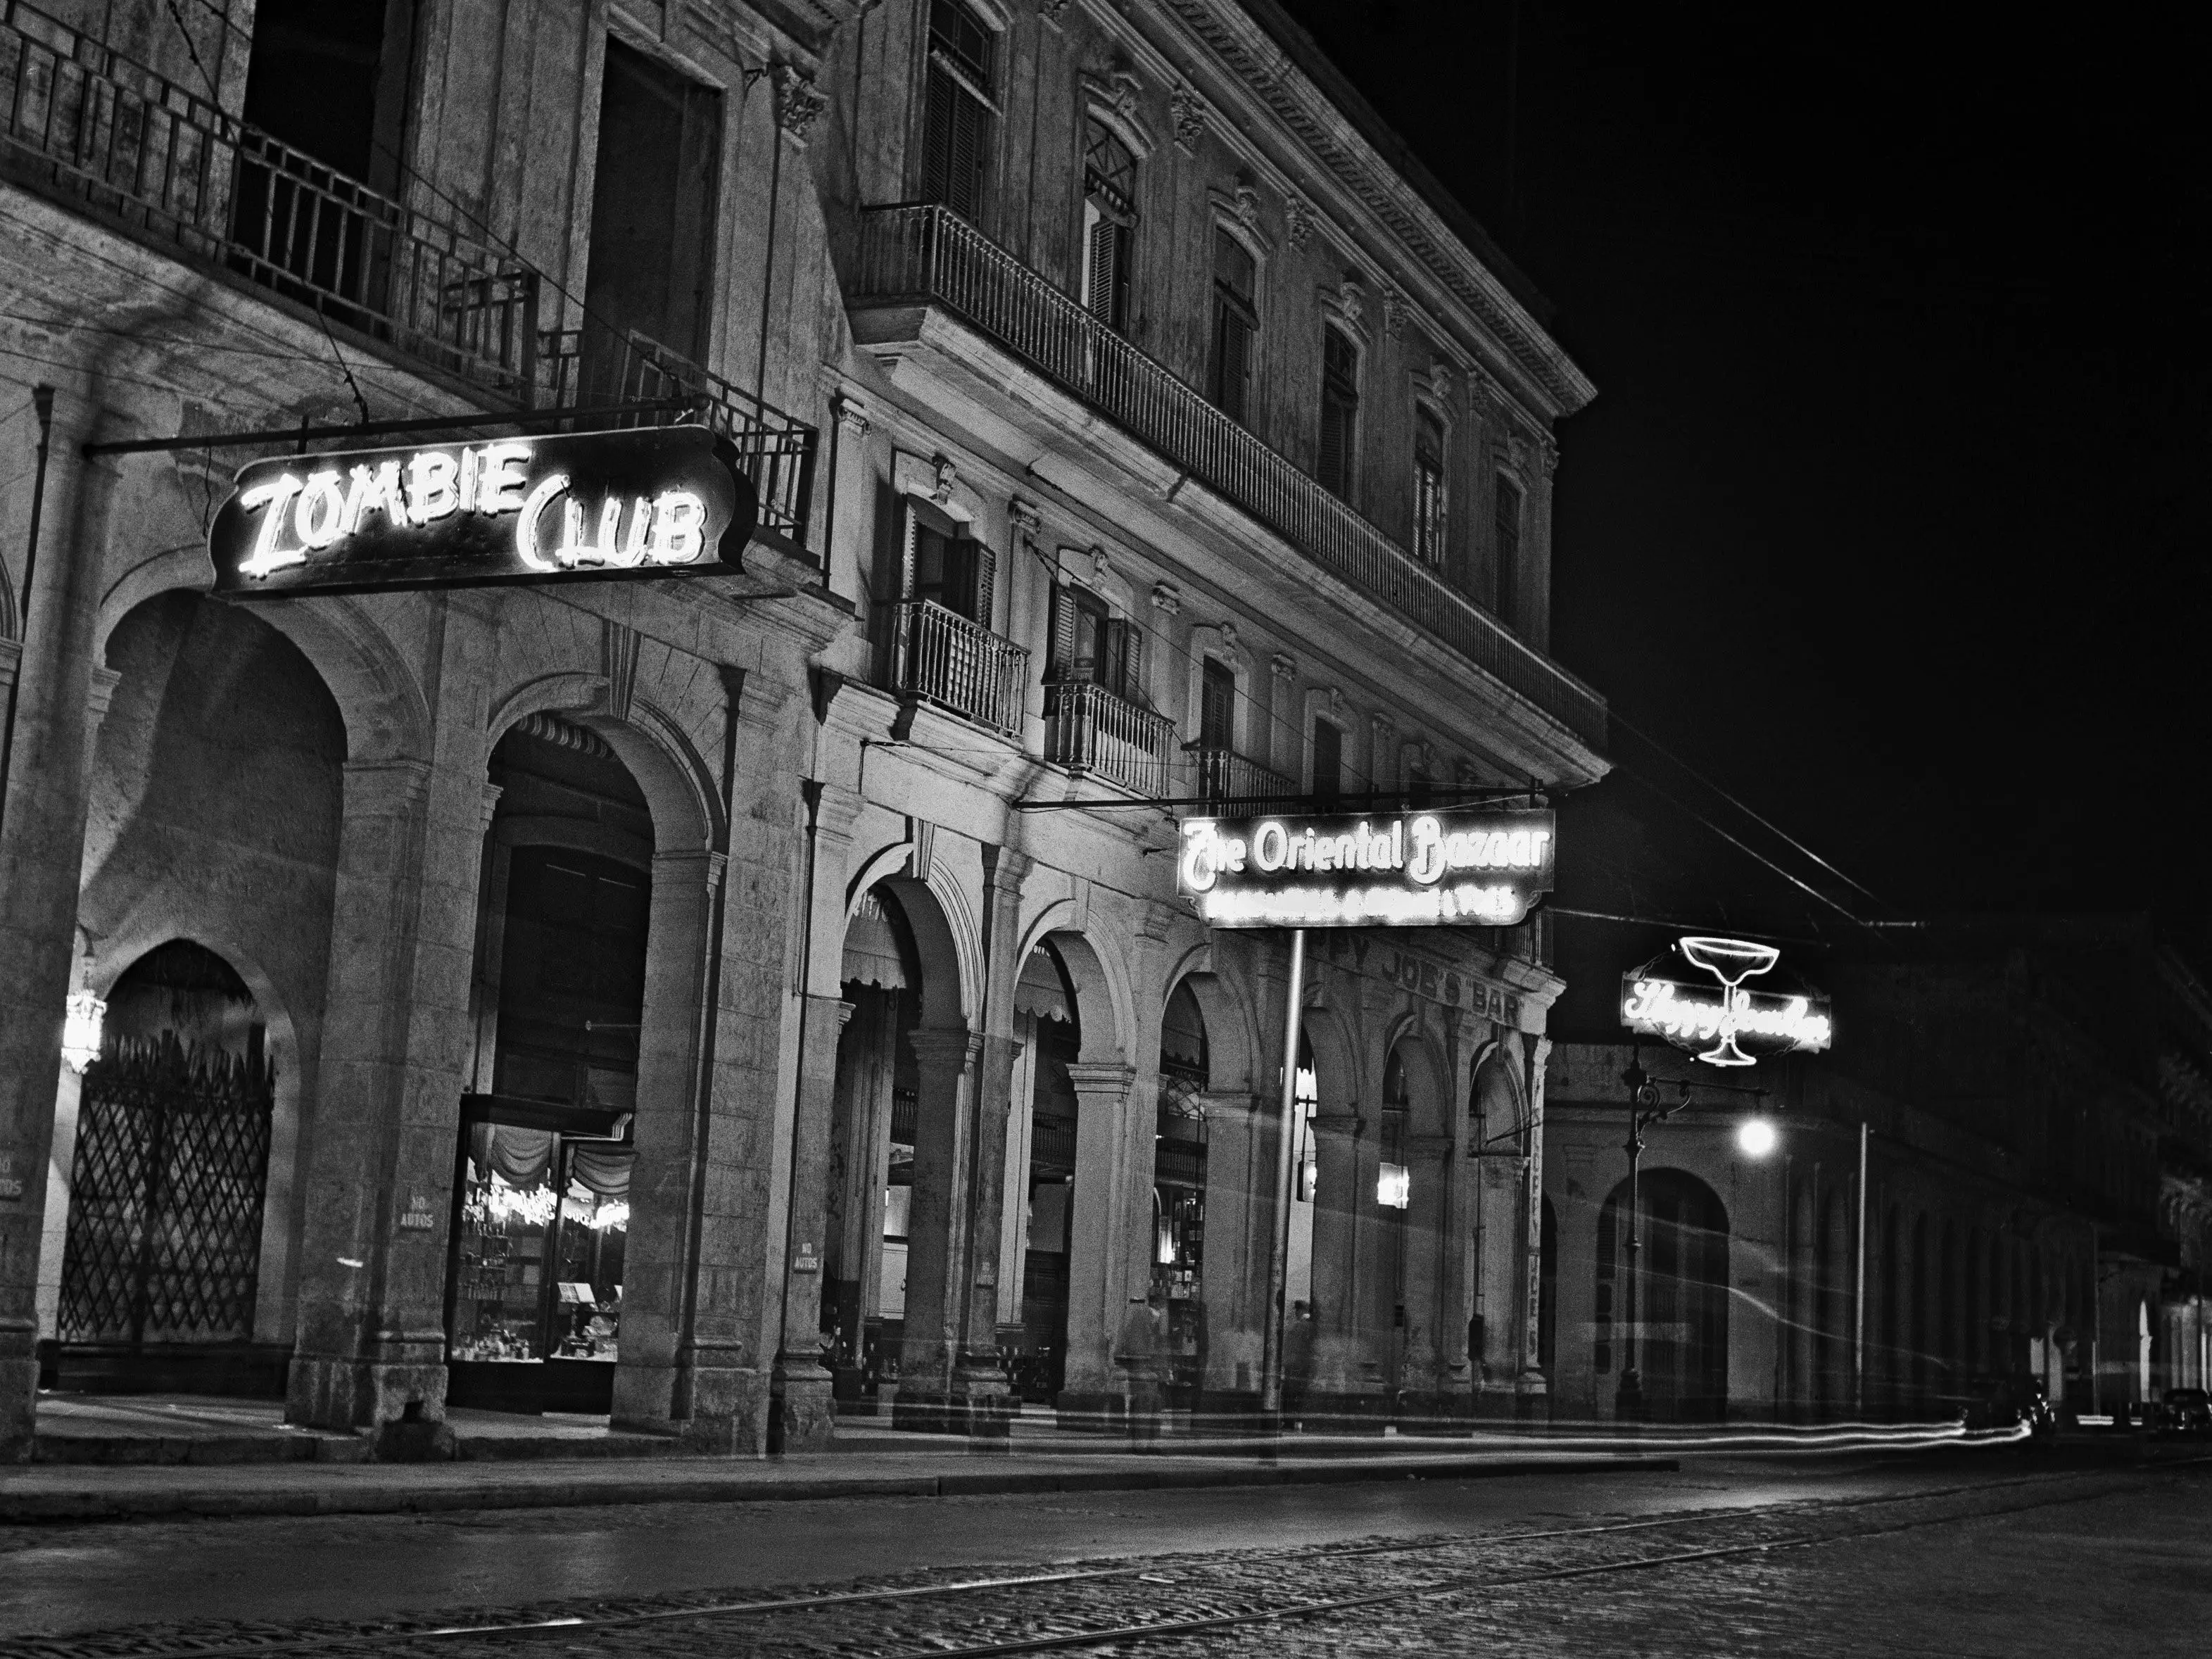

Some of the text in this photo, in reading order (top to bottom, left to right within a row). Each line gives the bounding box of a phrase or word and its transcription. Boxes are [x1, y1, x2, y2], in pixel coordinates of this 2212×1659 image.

[239, 444, 707, 577] ZOMBIE CLUB
[1183, 816, 1549, 890] The Oriental Bazaar
[400, 1213, 434, 1228] AUTOS
[410, 1195, 426, 1210] NO
